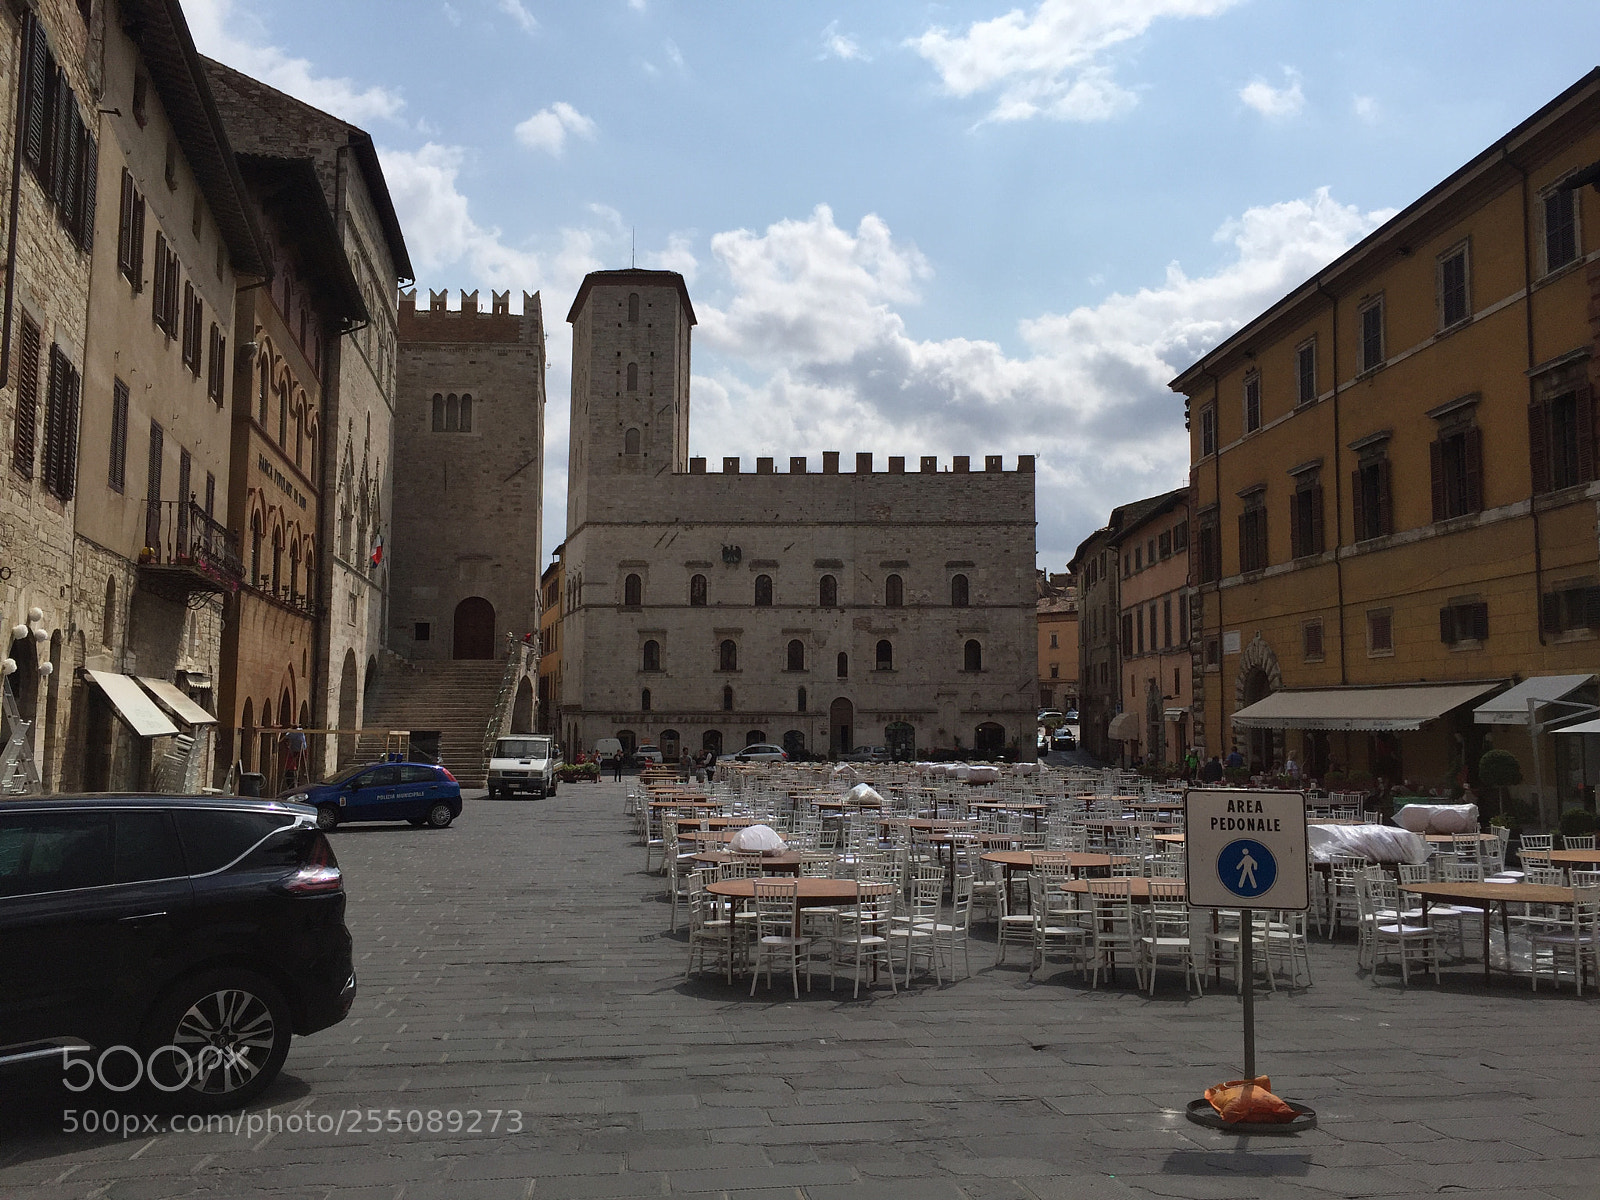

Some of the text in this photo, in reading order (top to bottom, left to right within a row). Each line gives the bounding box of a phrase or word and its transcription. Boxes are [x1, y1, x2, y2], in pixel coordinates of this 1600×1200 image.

[258, 453, 273, 480] BANCA
[396, 791, 425, 799] MUNICIPALE
[1227, 799, 1263, 814] AREA
[1210, 817, 1281, 832] PEDONALE
